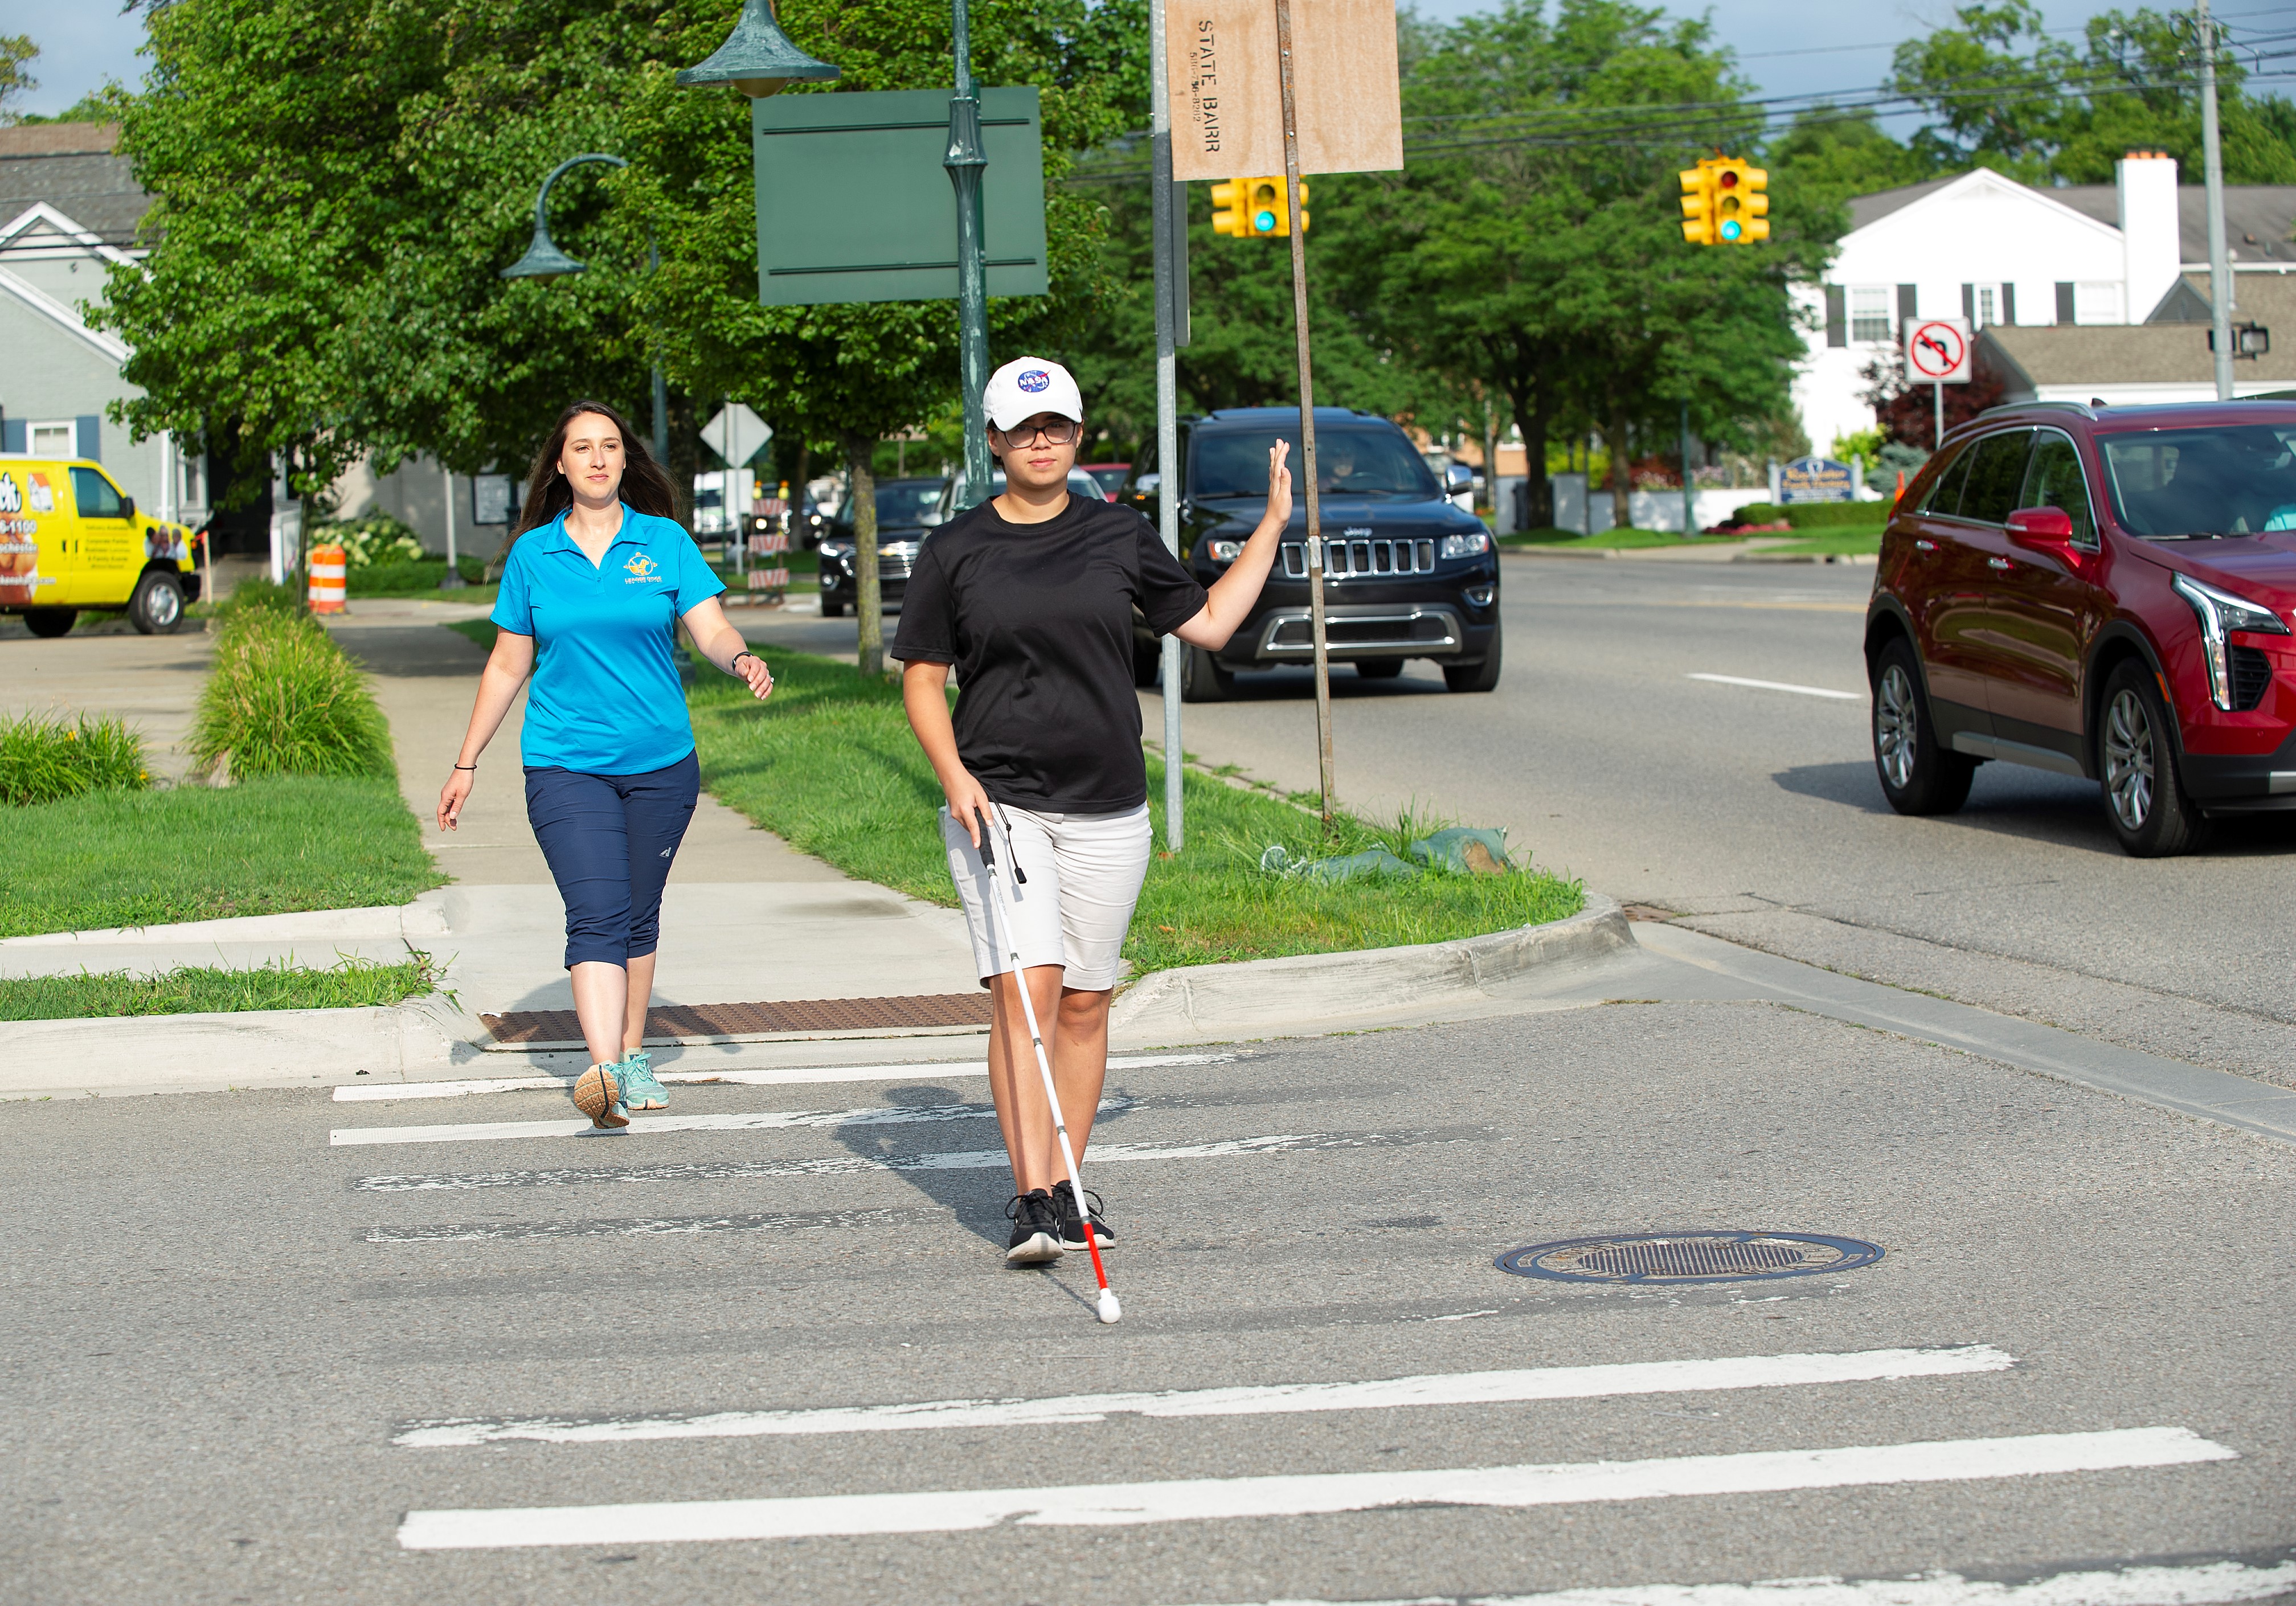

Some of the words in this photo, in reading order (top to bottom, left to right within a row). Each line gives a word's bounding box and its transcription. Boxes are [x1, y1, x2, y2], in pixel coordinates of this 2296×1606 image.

[1198, 20, 1217, 87] STATE
[1202, 97, 1220, 153] BARR
[1019, 376, 1049, 387] NASA
